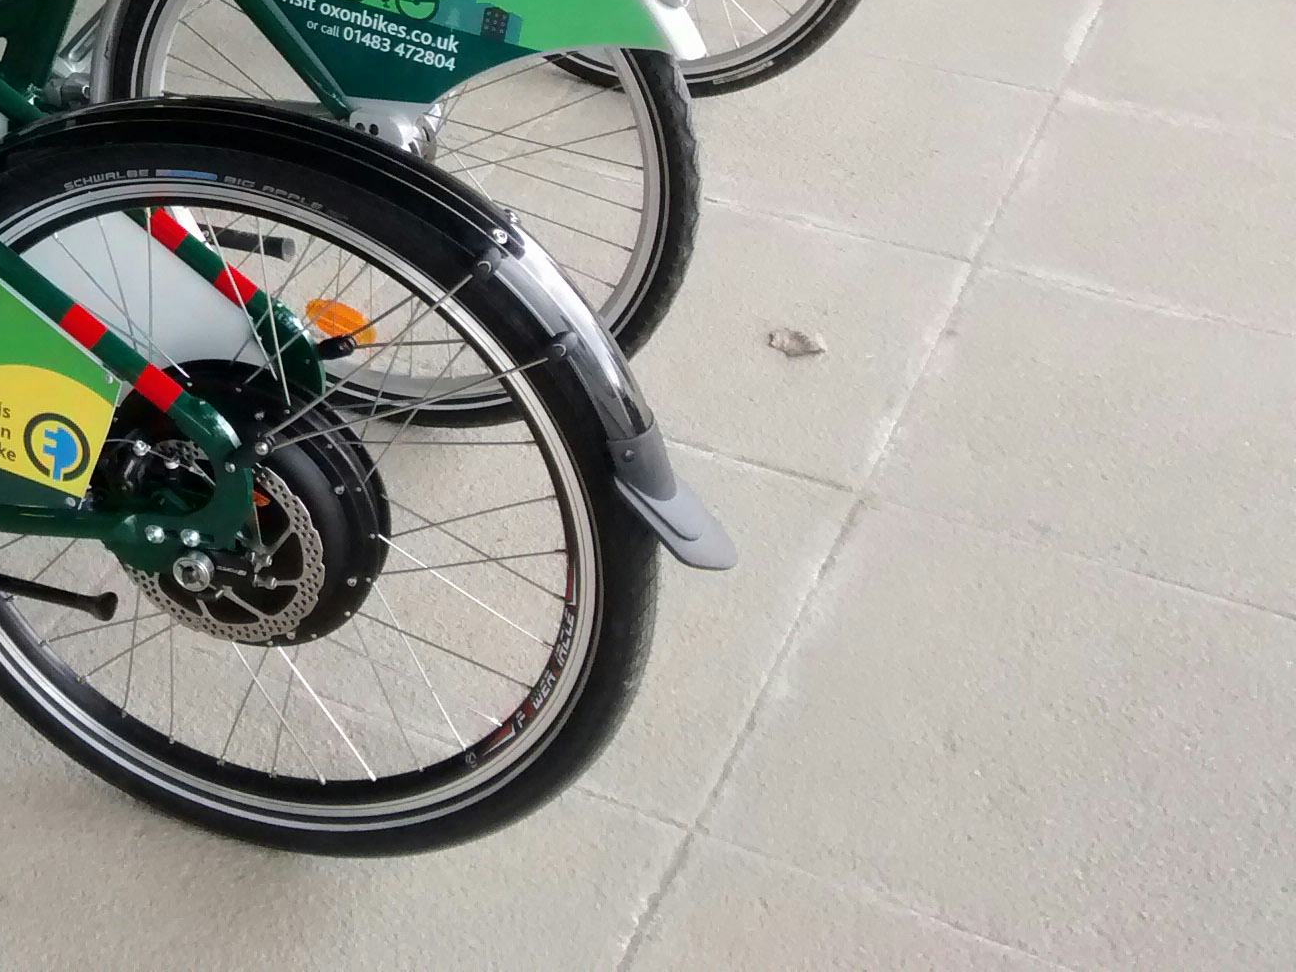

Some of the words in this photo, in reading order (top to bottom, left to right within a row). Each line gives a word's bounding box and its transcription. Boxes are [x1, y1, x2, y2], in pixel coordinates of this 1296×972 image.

[306, 20, 318, 30] or
[320, 24, 340, 38] call
[343, 26, 392, 53] 01483
[394, 42, 456, 72] 472804
[319, 1, 460, 54] oxonbikes.co.uk
[63, 168, 149, 191] SCHWALBE
[224, 174, 256, 188] BIG
